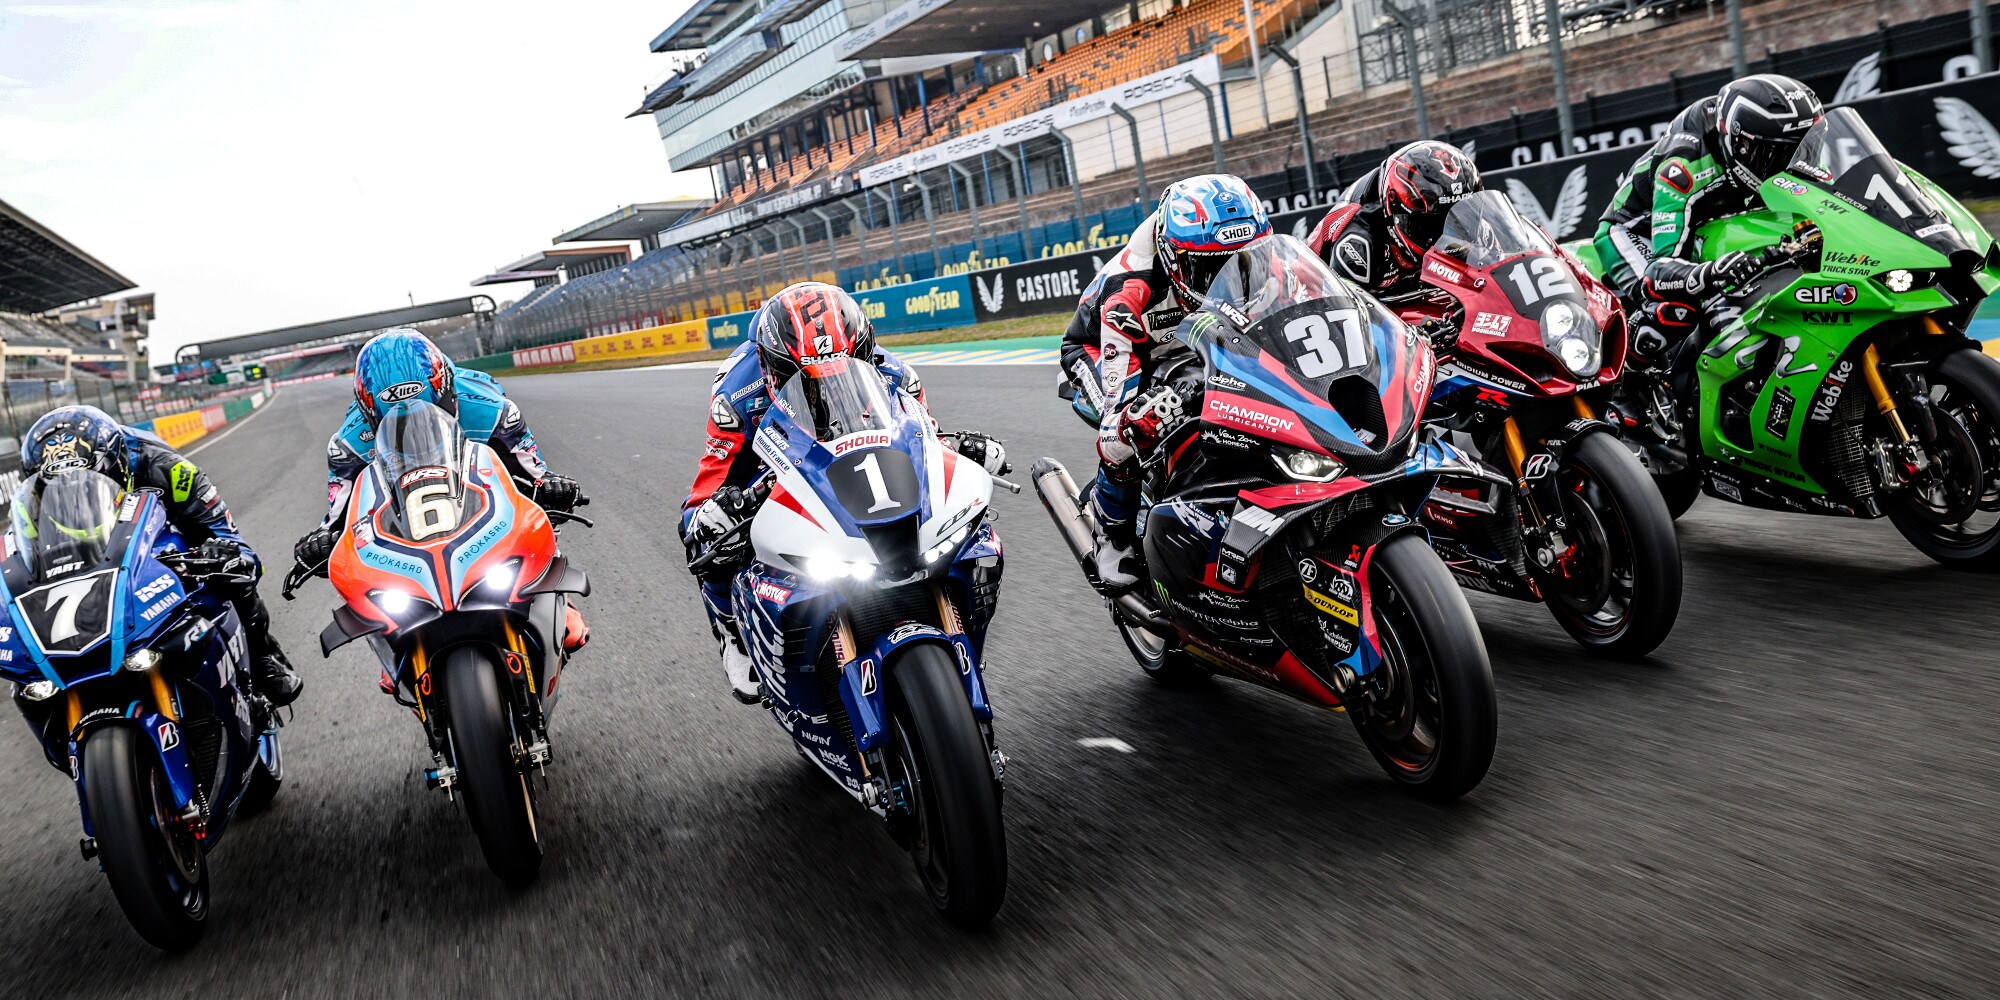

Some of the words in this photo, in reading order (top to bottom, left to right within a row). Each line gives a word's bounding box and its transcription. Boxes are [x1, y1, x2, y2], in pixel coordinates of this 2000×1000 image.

[1439, 192, 1474, 204] SHARK
[1820, 199, 1850, 215] KWT
[1221, 226, 1252, 241] SHOEI
[1427, 260, 1462, 284] MOTUL
[1823, 265, 1848, 274] TRICK
[1848, 267, 1871, 276] STAR
[1016, 268, 1081, 303] CASTORE
[1508, 256, 1576, 306] 12
[906, 286, 961, 318] GOODYEAR
[1795, 285, 1833, 303] elf
[1220, 302, 1250, 328] WRS
[1802, 311, 1853, 324] KWT
[1283, 309, 1368, 379] 37
[801, 350, 852, 366] SHARK
[1490, 375, 1528, 391] POWER
[1576, 380, 1602, 392] PIAA
[387, 385, 420, 402] X-lite
[1209, 399, 1292, 431] CHAMPION
[1217, 412, 1278, 433] LUBRICANTS
[756, 435, 776, 455] Honda
[770, 450, 791, 472] France
[835, 435, 889, 456] SHOWA
[50, 460, 81, 474] HJC
[401, 469, 448, 487] WRS
[853, 452, 902, 514] 1
[405, 483, 456, 542] 6
[1433, 512, 1454, 526] DENSO
[45, 560, 85, 579] YART
[1479, 558, 1501, 571] RK
[759, 582, 787, 602] MOTUL
[44, 576, 100, 645] 7
[140, 591, 182, 622] YAMAHA
[1313, 597, 1355, 619] DUNLOP
[183, 617, 209, 651] R1
[78, 706, 121, 725] YAMAHA
[818, 747, 849, 768] NGK
